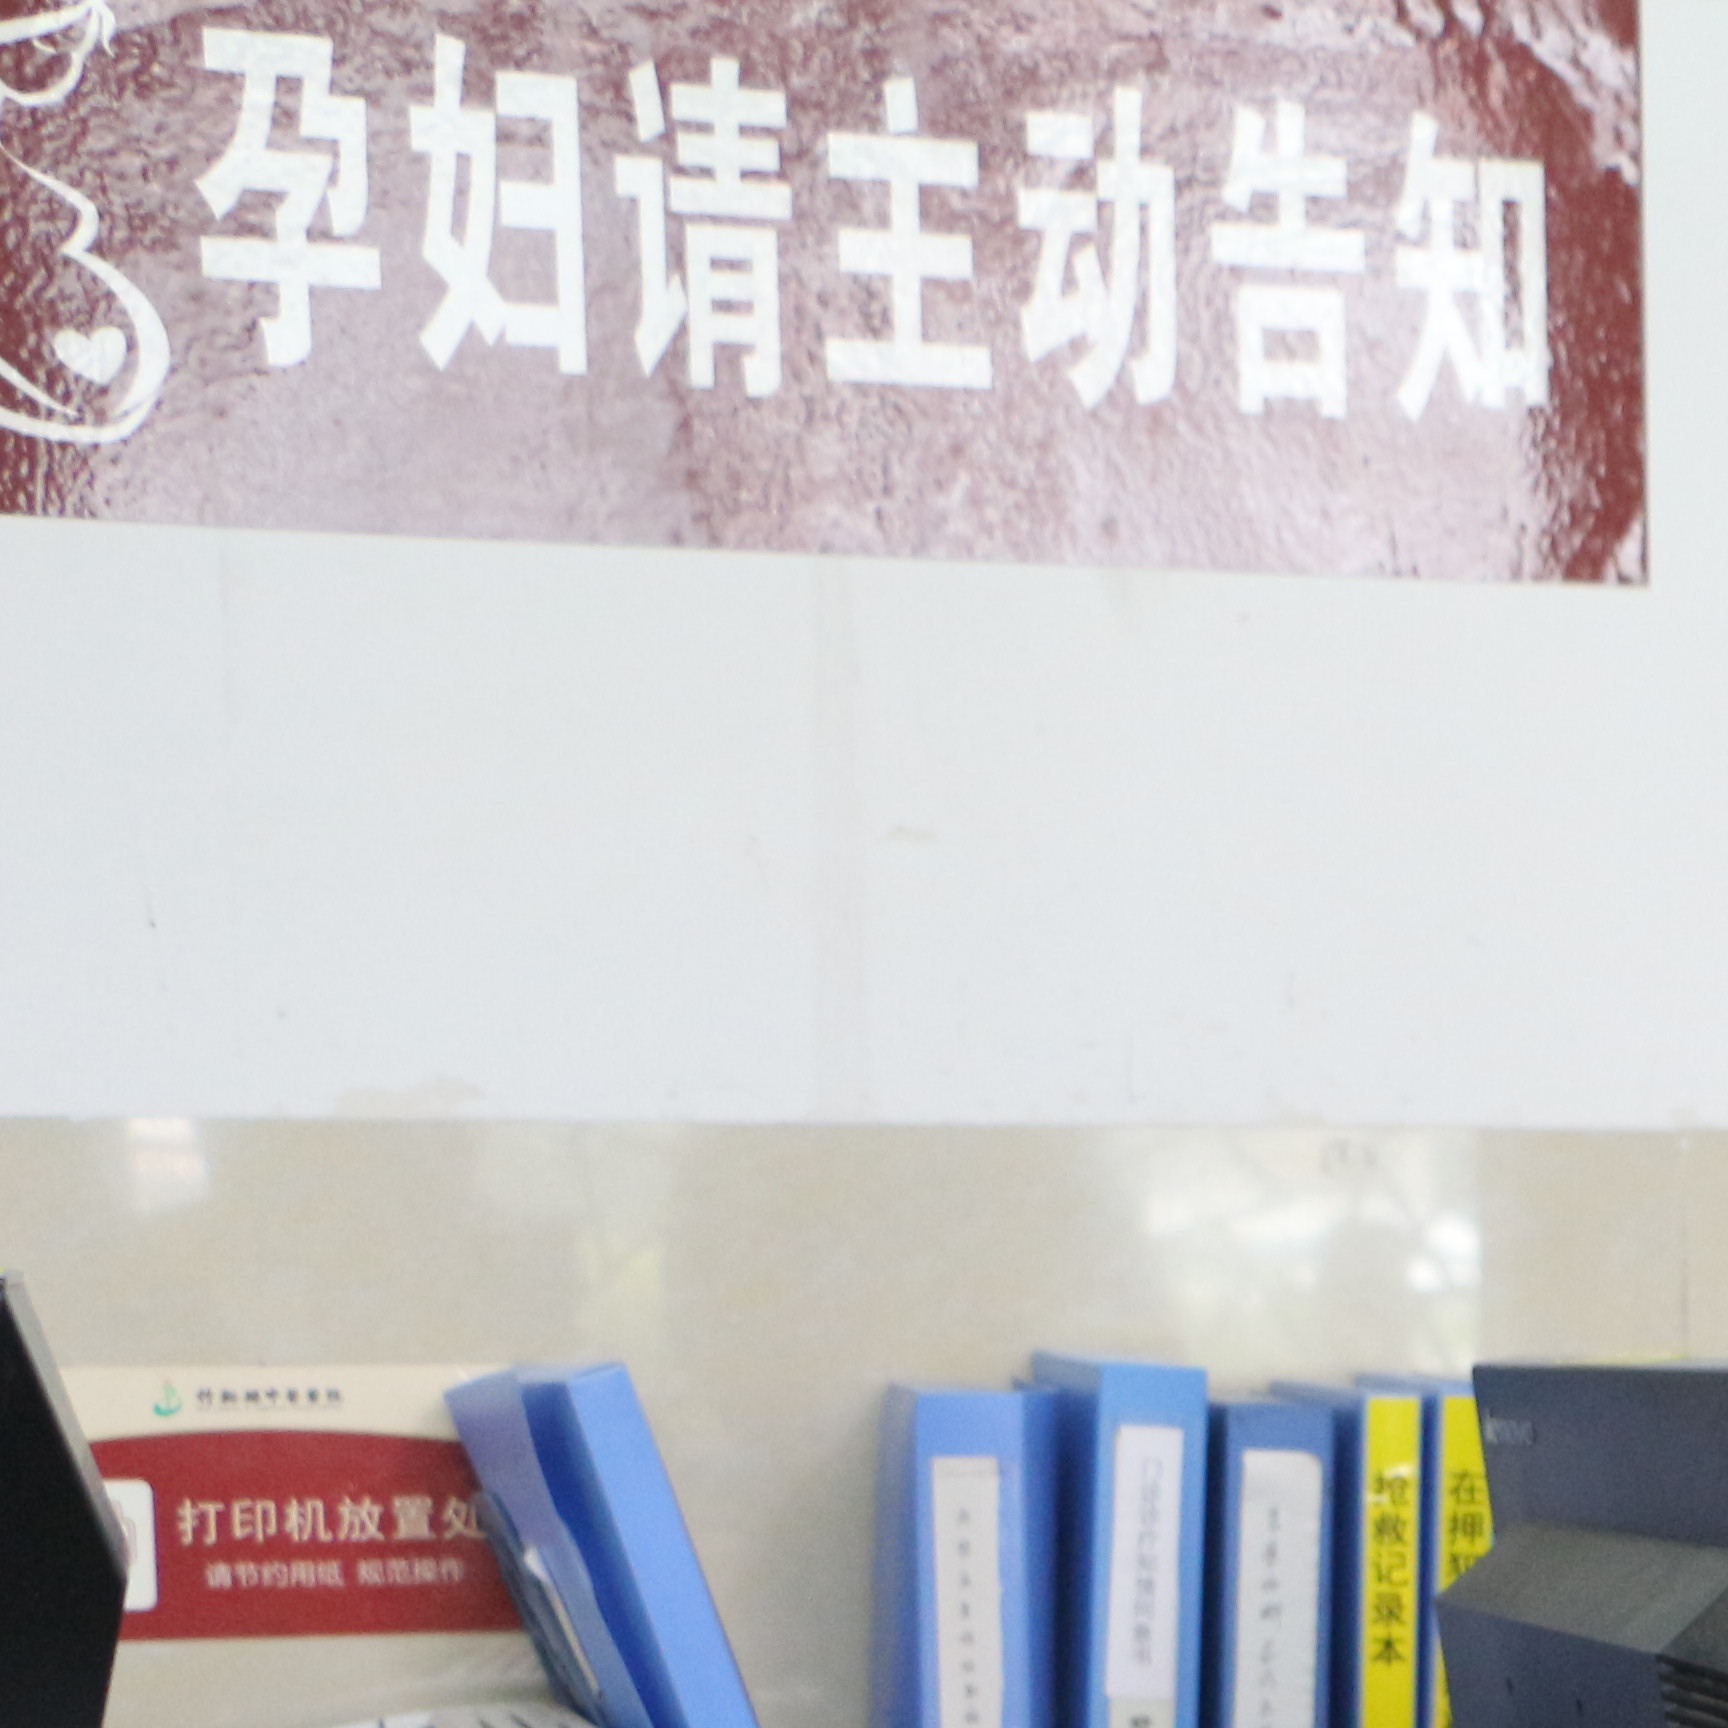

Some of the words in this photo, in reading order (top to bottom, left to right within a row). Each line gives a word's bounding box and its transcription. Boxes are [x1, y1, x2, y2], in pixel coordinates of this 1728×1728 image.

[195, 28, 1551, 420] 孕妇请主动告知
[176, 1496, 488, 1547] 打印机放置处
[204, 1560, 346, 1590] 请节约用纸
[356, 1556, 466, 1586] 规范操作
[1372, 1468, 1409, 1668] 抢救记录本
